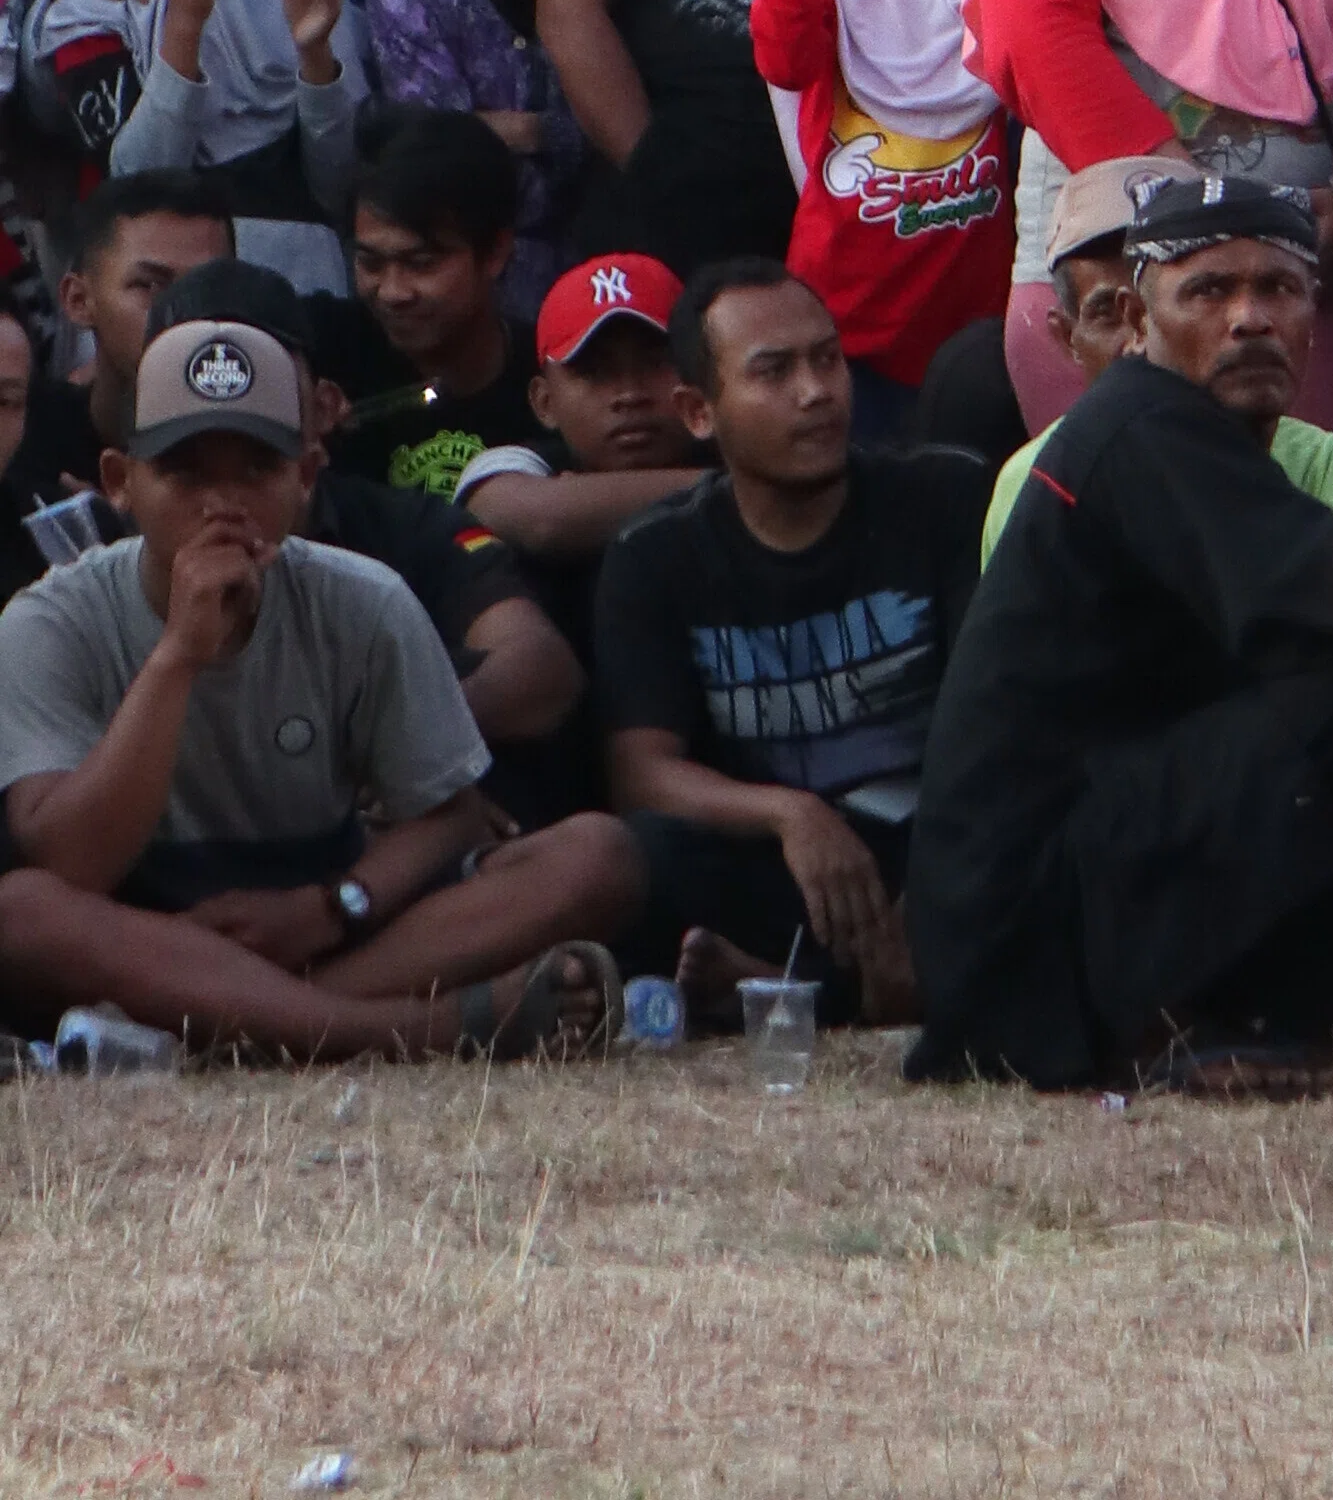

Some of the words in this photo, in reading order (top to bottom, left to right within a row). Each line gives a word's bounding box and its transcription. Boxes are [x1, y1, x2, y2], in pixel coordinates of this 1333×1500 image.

[861, 153, 998, 218] Smile
[591, 266, 631, 304] NY
[196, 371, 247, 387] SECOND
[201, 359, 241, 374] THREE
